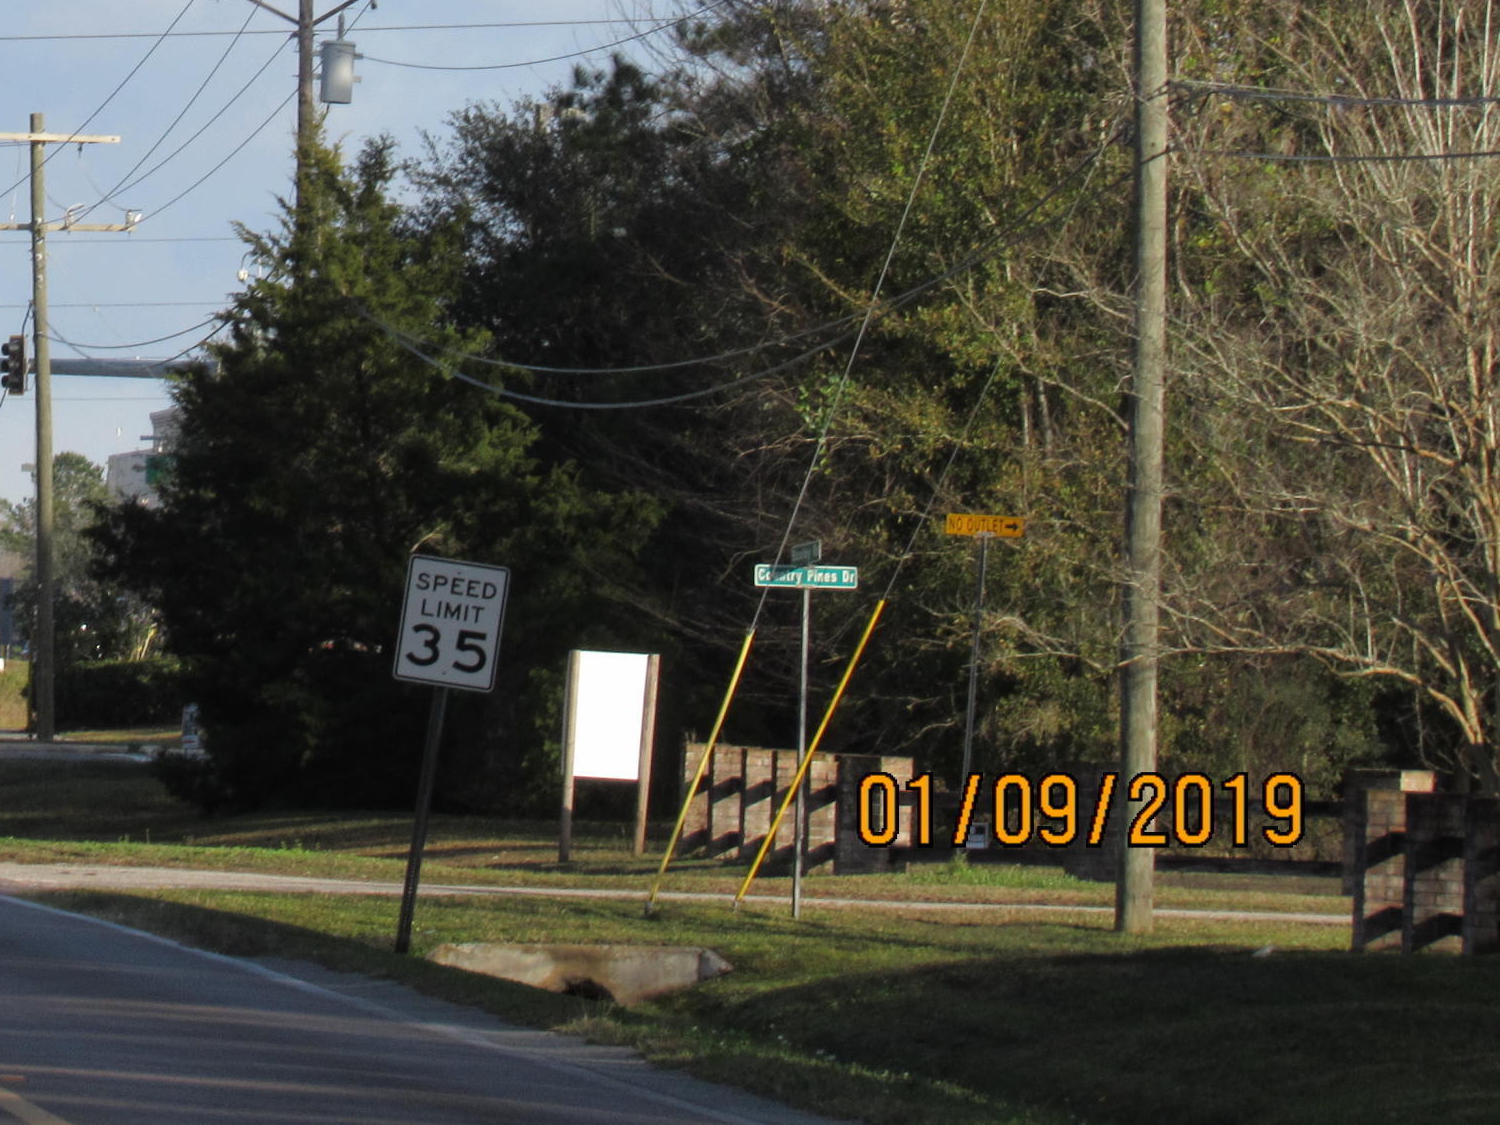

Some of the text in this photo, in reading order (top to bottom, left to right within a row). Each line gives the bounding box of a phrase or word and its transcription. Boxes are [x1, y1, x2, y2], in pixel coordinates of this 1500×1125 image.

[948, 516, 1005, 533] NO OUTLET
[415, 572, 498, 600] SPEED
[806, 569, 838, 583] Pines
[841, 570, 855, 584] Dr
[420, 598, 485, 624] LIMIT
[405, 623, 488, 674] 35
